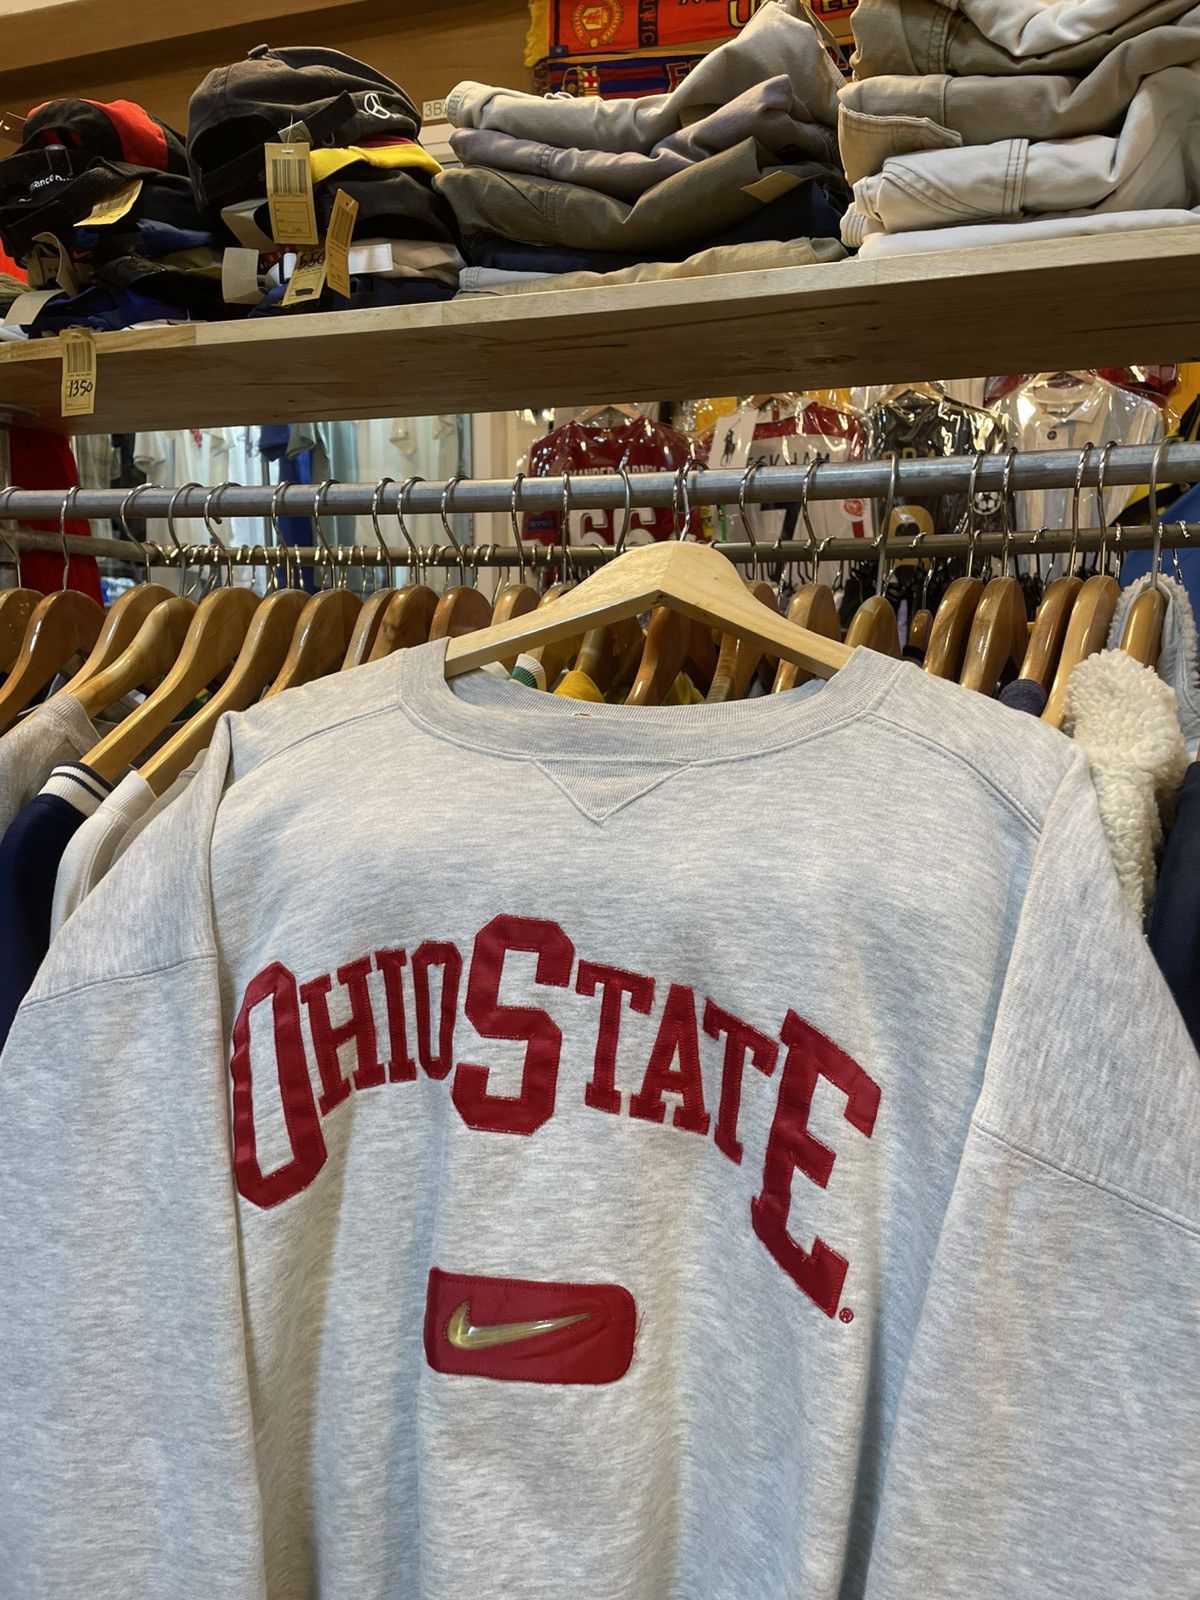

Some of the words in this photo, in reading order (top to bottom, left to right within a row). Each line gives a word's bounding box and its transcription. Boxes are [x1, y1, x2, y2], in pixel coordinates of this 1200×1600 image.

[68, 380, 93, 398] 1350
[567, 508, 657, 548] 66
[231, 940, 462, 1208] OHIO
[450, 914, 881, 1318] STATE
